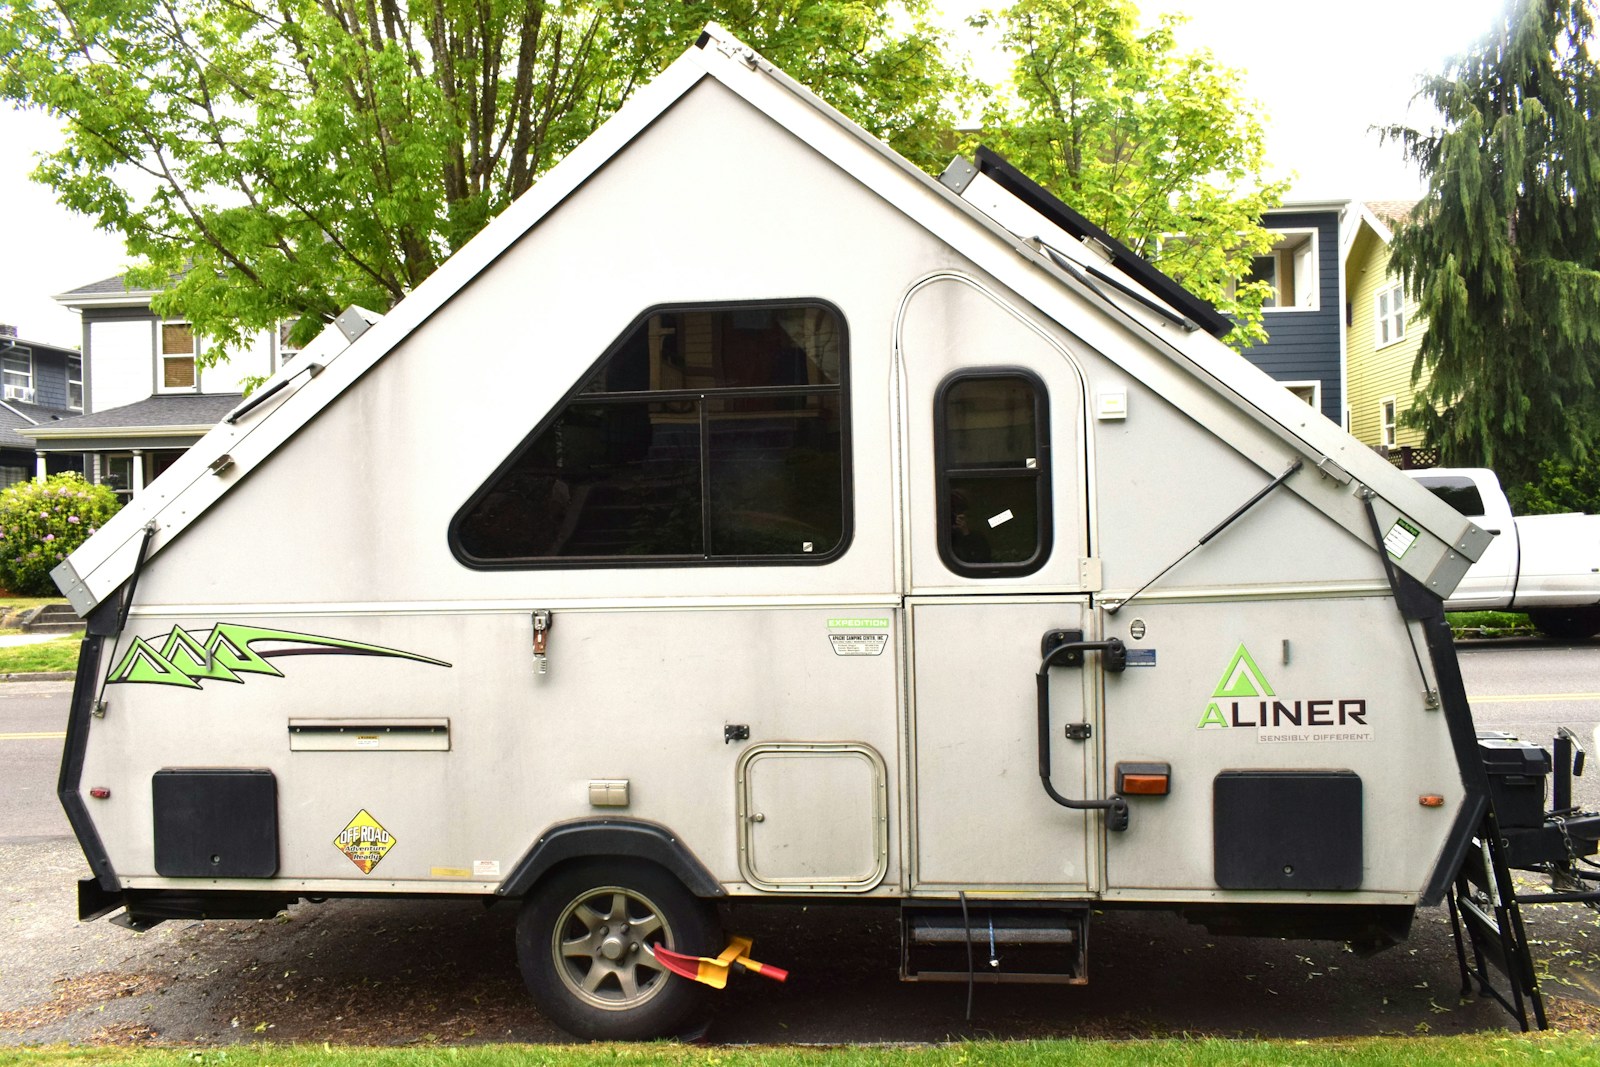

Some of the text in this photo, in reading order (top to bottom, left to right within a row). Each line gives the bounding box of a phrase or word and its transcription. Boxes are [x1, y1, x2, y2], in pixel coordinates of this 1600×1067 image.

[828, 619, 888, 627] EXPEDITION
[1197, 699, 1368, 728] ALINER
[1260, 733, 1373, 742] SENSIBLY DIFFERENT.
[340, 825, 389, 844] OFF ROAD
